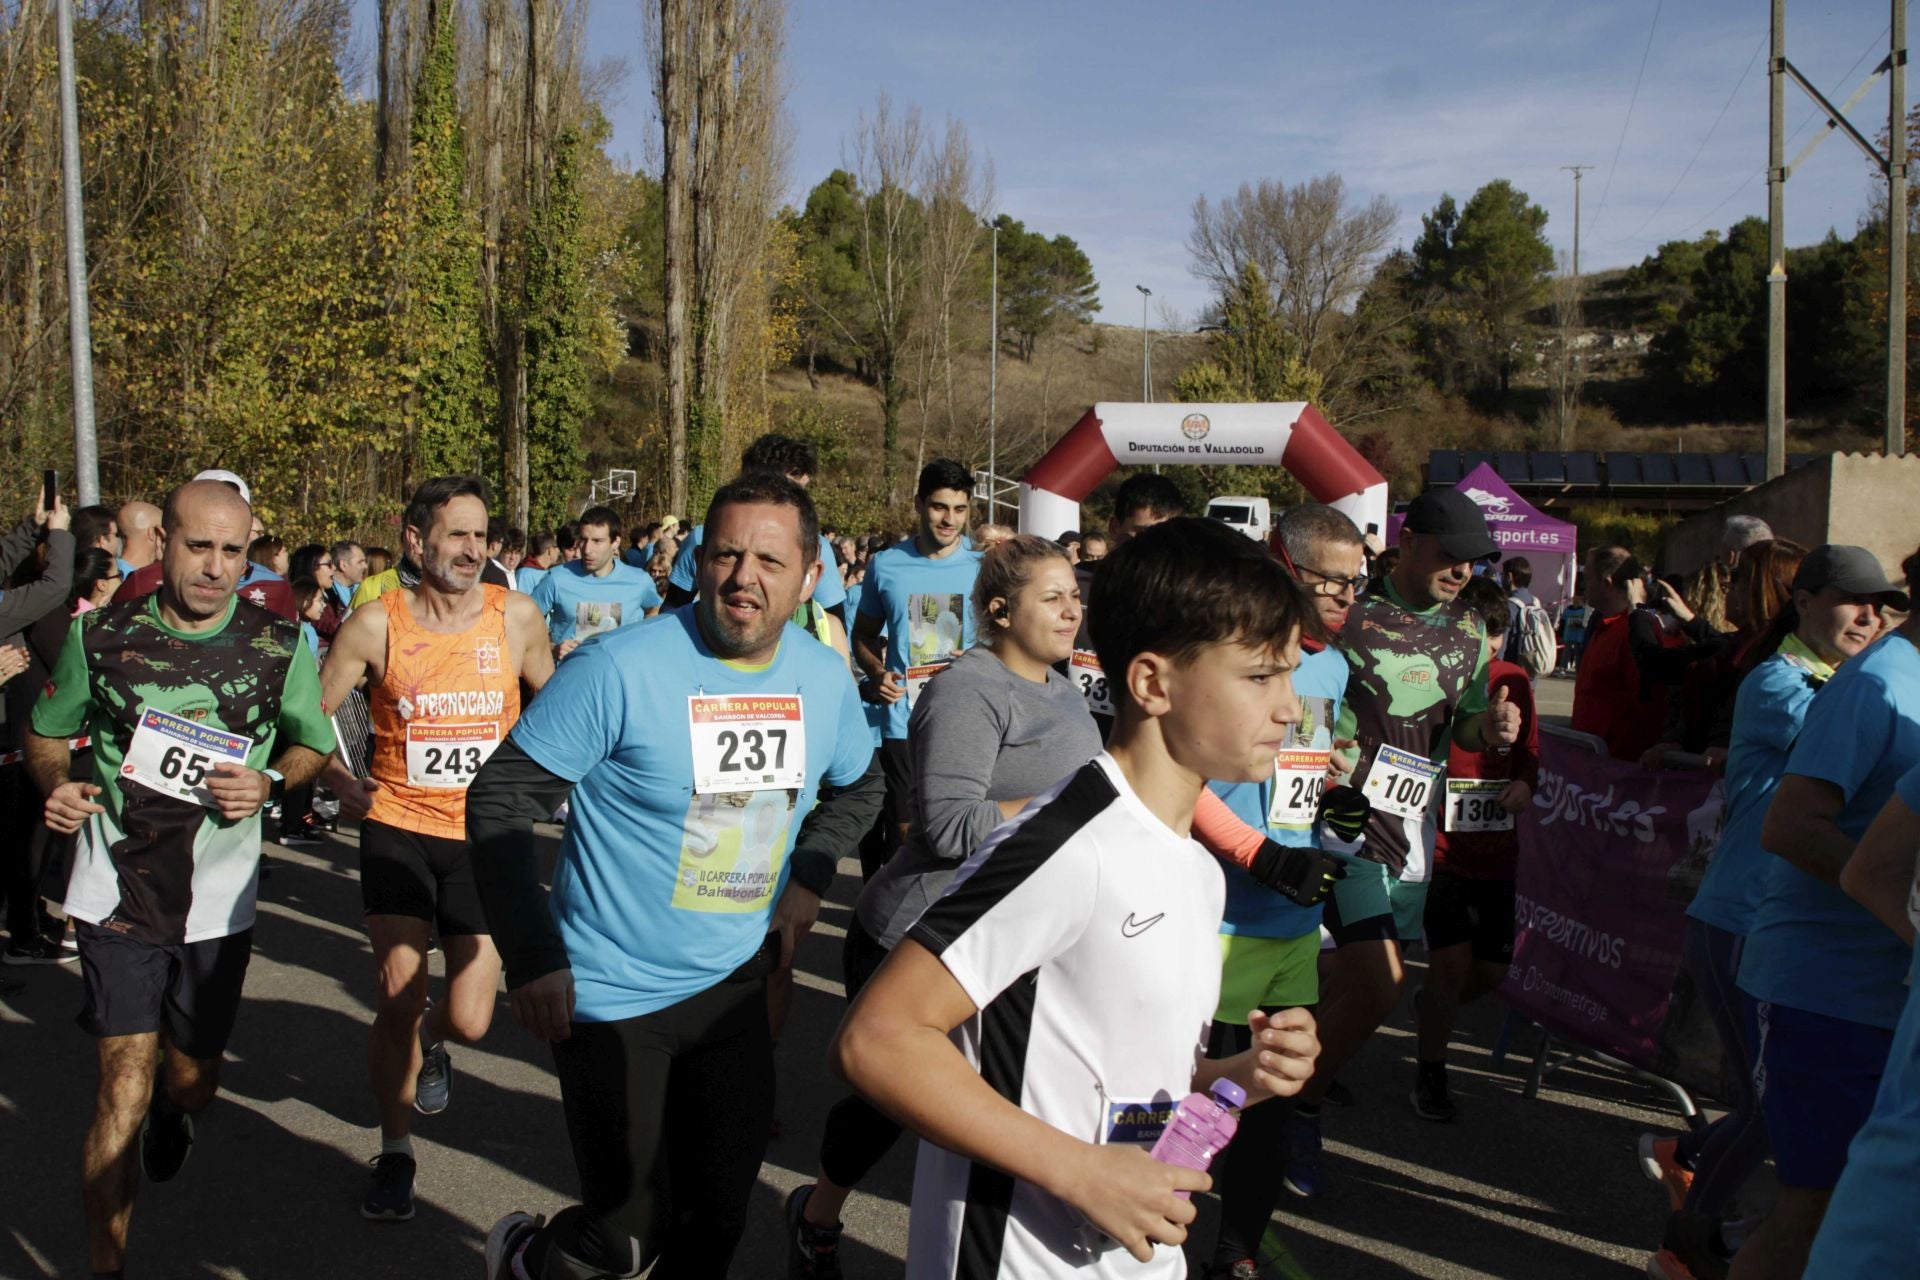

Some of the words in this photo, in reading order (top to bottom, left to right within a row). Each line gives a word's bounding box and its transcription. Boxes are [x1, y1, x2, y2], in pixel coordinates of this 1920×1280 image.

[1204, 444, 1264, 454] VALLADOLID
[1484, 513, 1528, 522] SPORT
[1488, 530, 1559, 546] sport.es
[1402, 671, 1430, 684] ATP
[1080, 673, 1108, 702] 33
[416, 690, 504, 717] TECNOCASA
[695, 702, 749, 712] CARRERA
[752, 702, 797, 711] POPULAR
[412, 728, 453, 736] CARRERA
[456, 727, 494, 736] POPULAR
[199, 731, 245, 751] POPULR
[717, 729, 787, 772] 237
[160, 746, 210, 787] 65
[425, 747, 481, 775] 243
[1279, 755, 1313, 763] CARRERA
[1288, 777, 1324, 808] 249
[1384, 773, 1426, 807] 100
[707, 871, 746, 884] CARRERA
[1137, 1130, 1162, 1139] BAHA
